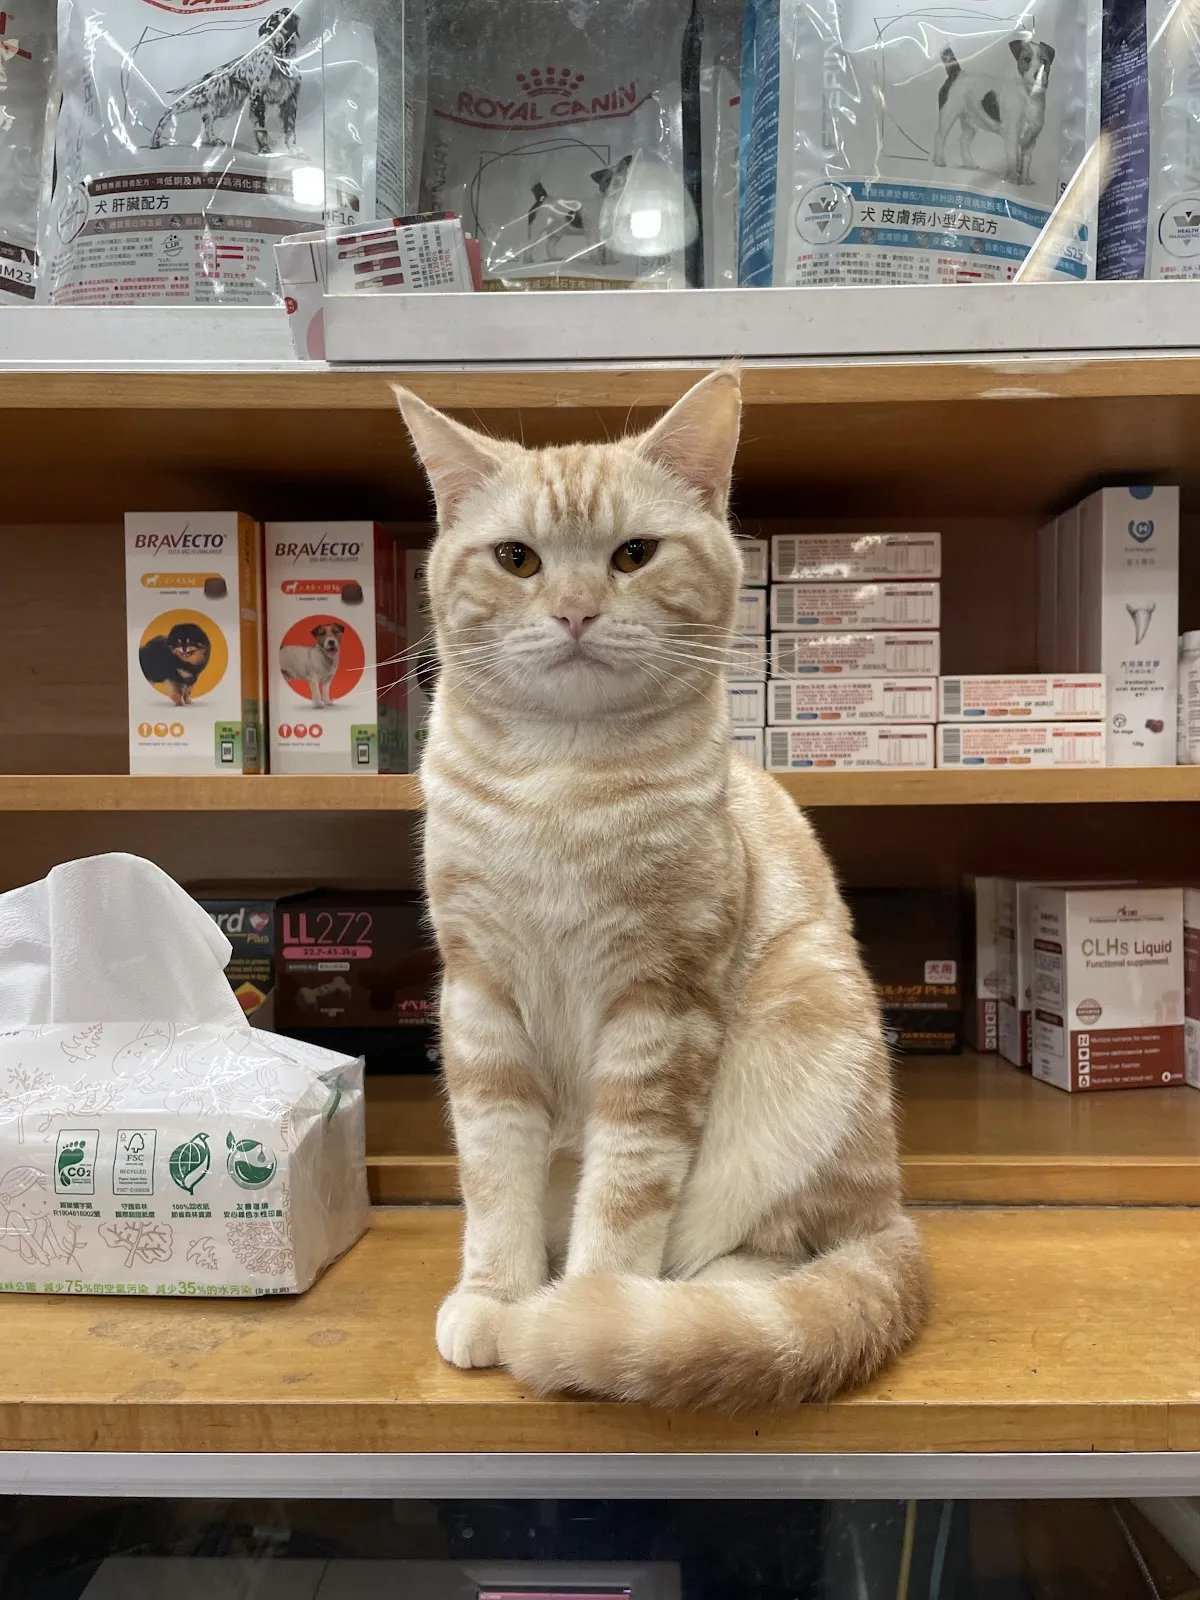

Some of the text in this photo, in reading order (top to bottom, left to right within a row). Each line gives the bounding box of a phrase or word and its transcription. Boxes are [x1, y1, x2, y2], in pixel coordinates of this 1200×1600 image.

[457, 81, 637, 121] ROYAL CANIN
[94, 195, 170, 214] 犬 肝臟配方
[860, 207, 998, 235] 犬 皮膚病小型犬配方
[135, 528, 223, 552] BRAVECTO
[275, 536, 361, 559] BRAVECTO
[283, 912, 373, 944] LL272
[1081, 937, 1172, 957] CLHs Liquid
[1086, 957, 1169, 968] Functional supplement
[43, 1280, 149, 1294] 減少75%的空氣污染
[156, 1281, 252, 1295] 減少35%的水污染
